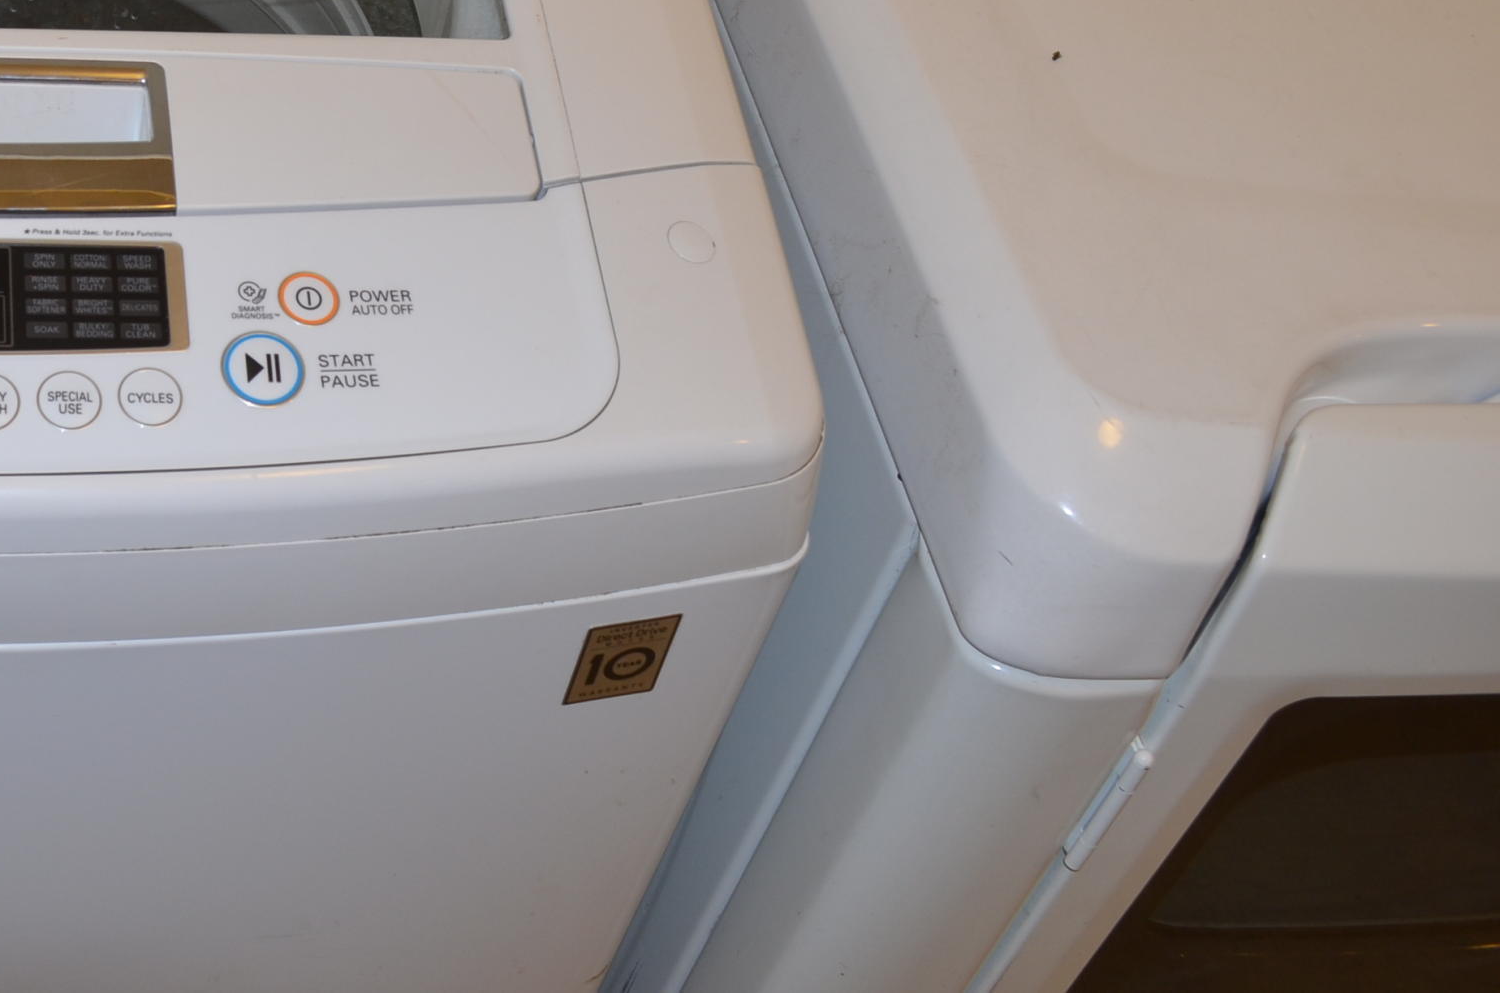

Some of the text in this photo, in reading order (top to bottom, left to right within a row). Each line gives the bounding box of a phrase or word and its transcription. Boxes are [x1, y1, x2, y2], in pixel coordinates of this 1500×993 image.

[34, 253, 55, 261] SPIN
[349, 290, 412, 302] POWER
[352, 304, 414, 315] AUTO OFF
[318, 354, 375, 368] START
[321, 374, 380, 388] PAUSE
[47, 391, 93, 403] SPECIAL
[127, 392, 174, 404] CYCLES
[58, 403, 83, 414] USE
[584, 647, 656, 686] 10
